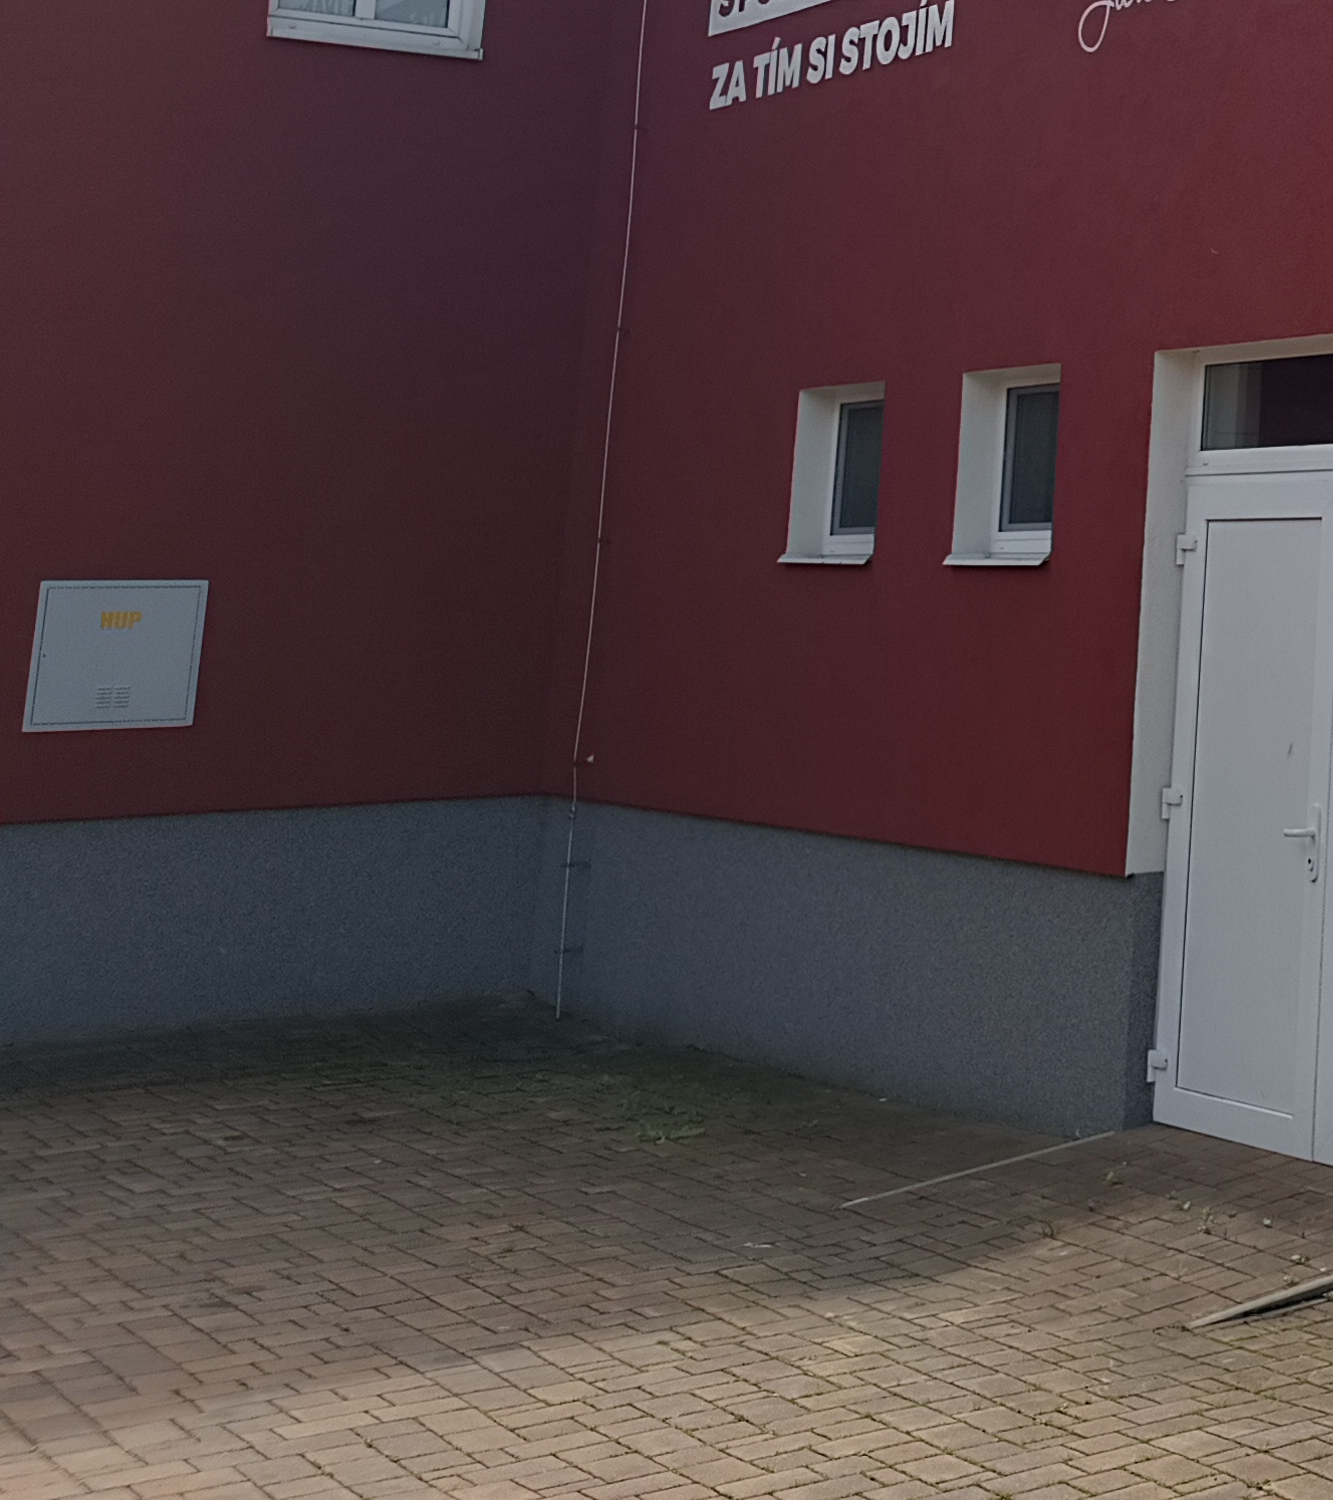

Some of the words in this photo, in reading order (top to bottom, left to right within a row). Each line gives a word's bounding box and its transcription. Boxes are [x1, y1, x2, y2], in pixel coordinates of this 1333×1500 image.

[709, 59, 747, 111] ZA
[752, 37, 802, 99] TÍM
[806, 34, 836, 85] SI
[101, 611, 143, 629] HUP
